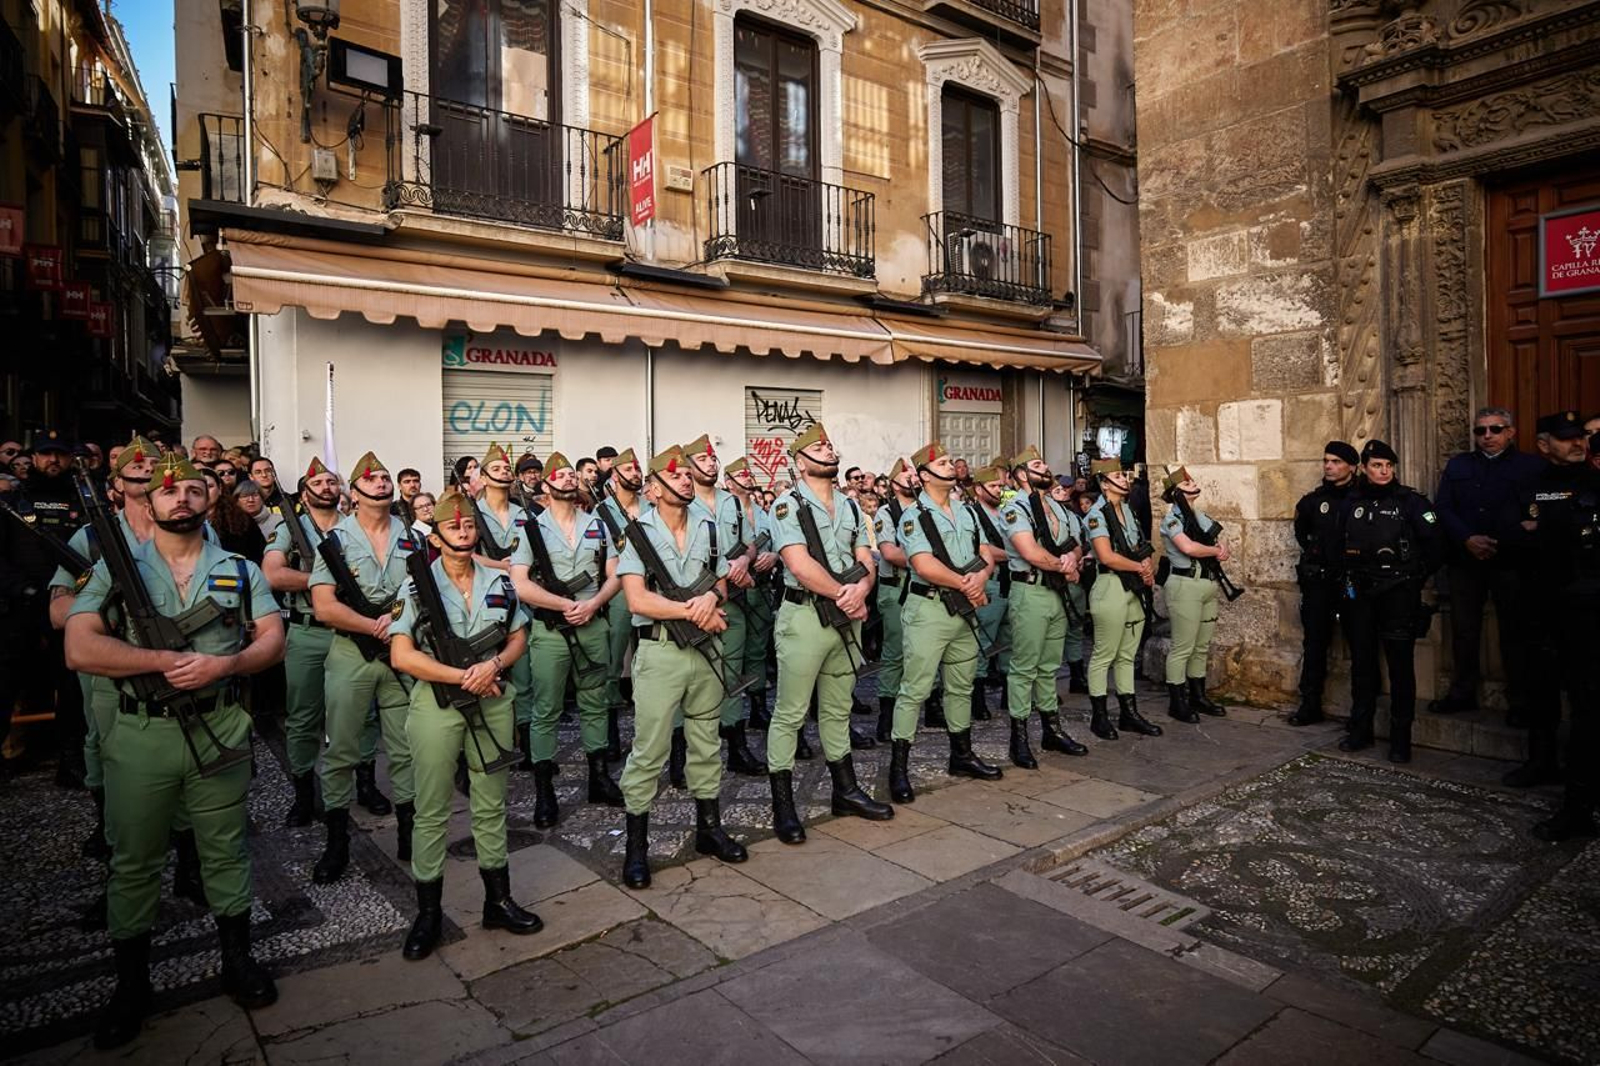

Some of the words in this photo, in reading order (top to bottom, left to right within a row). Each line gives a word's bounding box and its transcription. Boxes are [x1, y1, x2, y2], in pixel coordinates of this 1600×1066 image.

[635, 196, 652, 214] ALIVE
[1551, 261, 1589, 272] CAPILLA
[1551, 271, 1565, 279] DE
[466, 347, 558, 368] GRANADA
